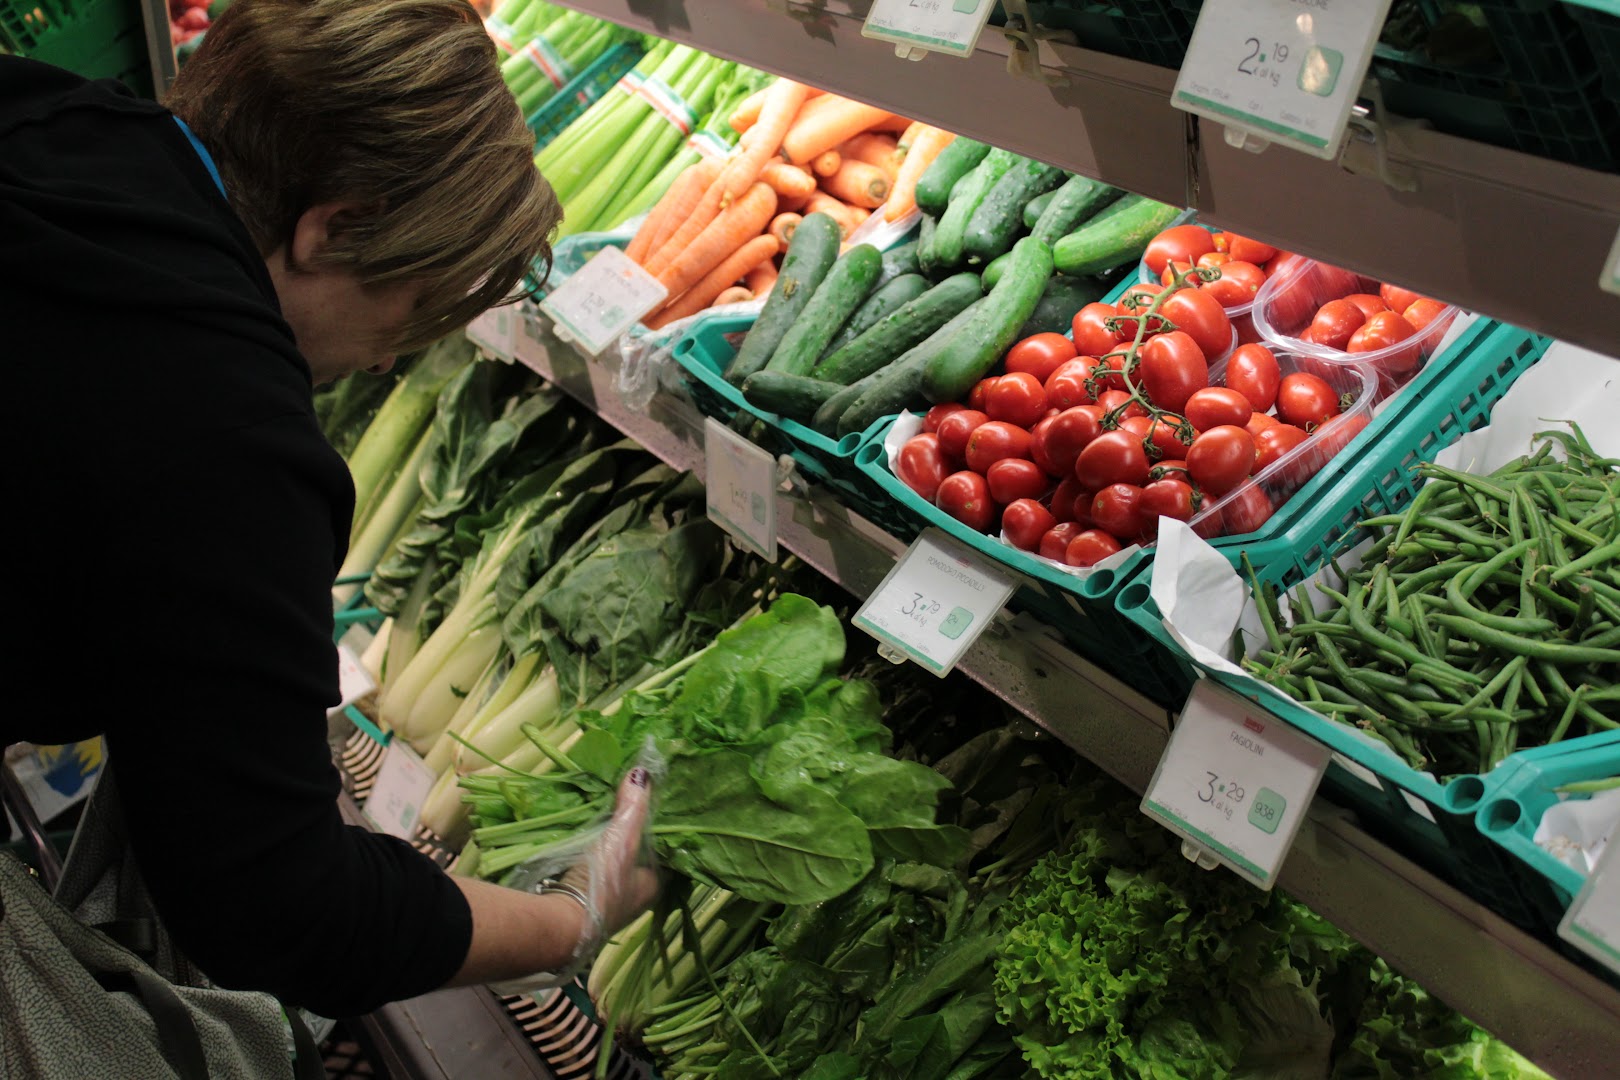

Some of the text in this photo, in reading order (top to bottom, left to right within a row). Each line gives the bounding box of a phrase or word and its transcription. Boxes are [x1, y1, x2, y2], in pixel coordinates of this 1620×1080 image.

[1270, 69, 1281, 87] kg
[1230, 730, 1265, 756] FAGIOLINI
[1224, 804, 1233, 821] kg
[1254, 802, 1275, 821] 938
